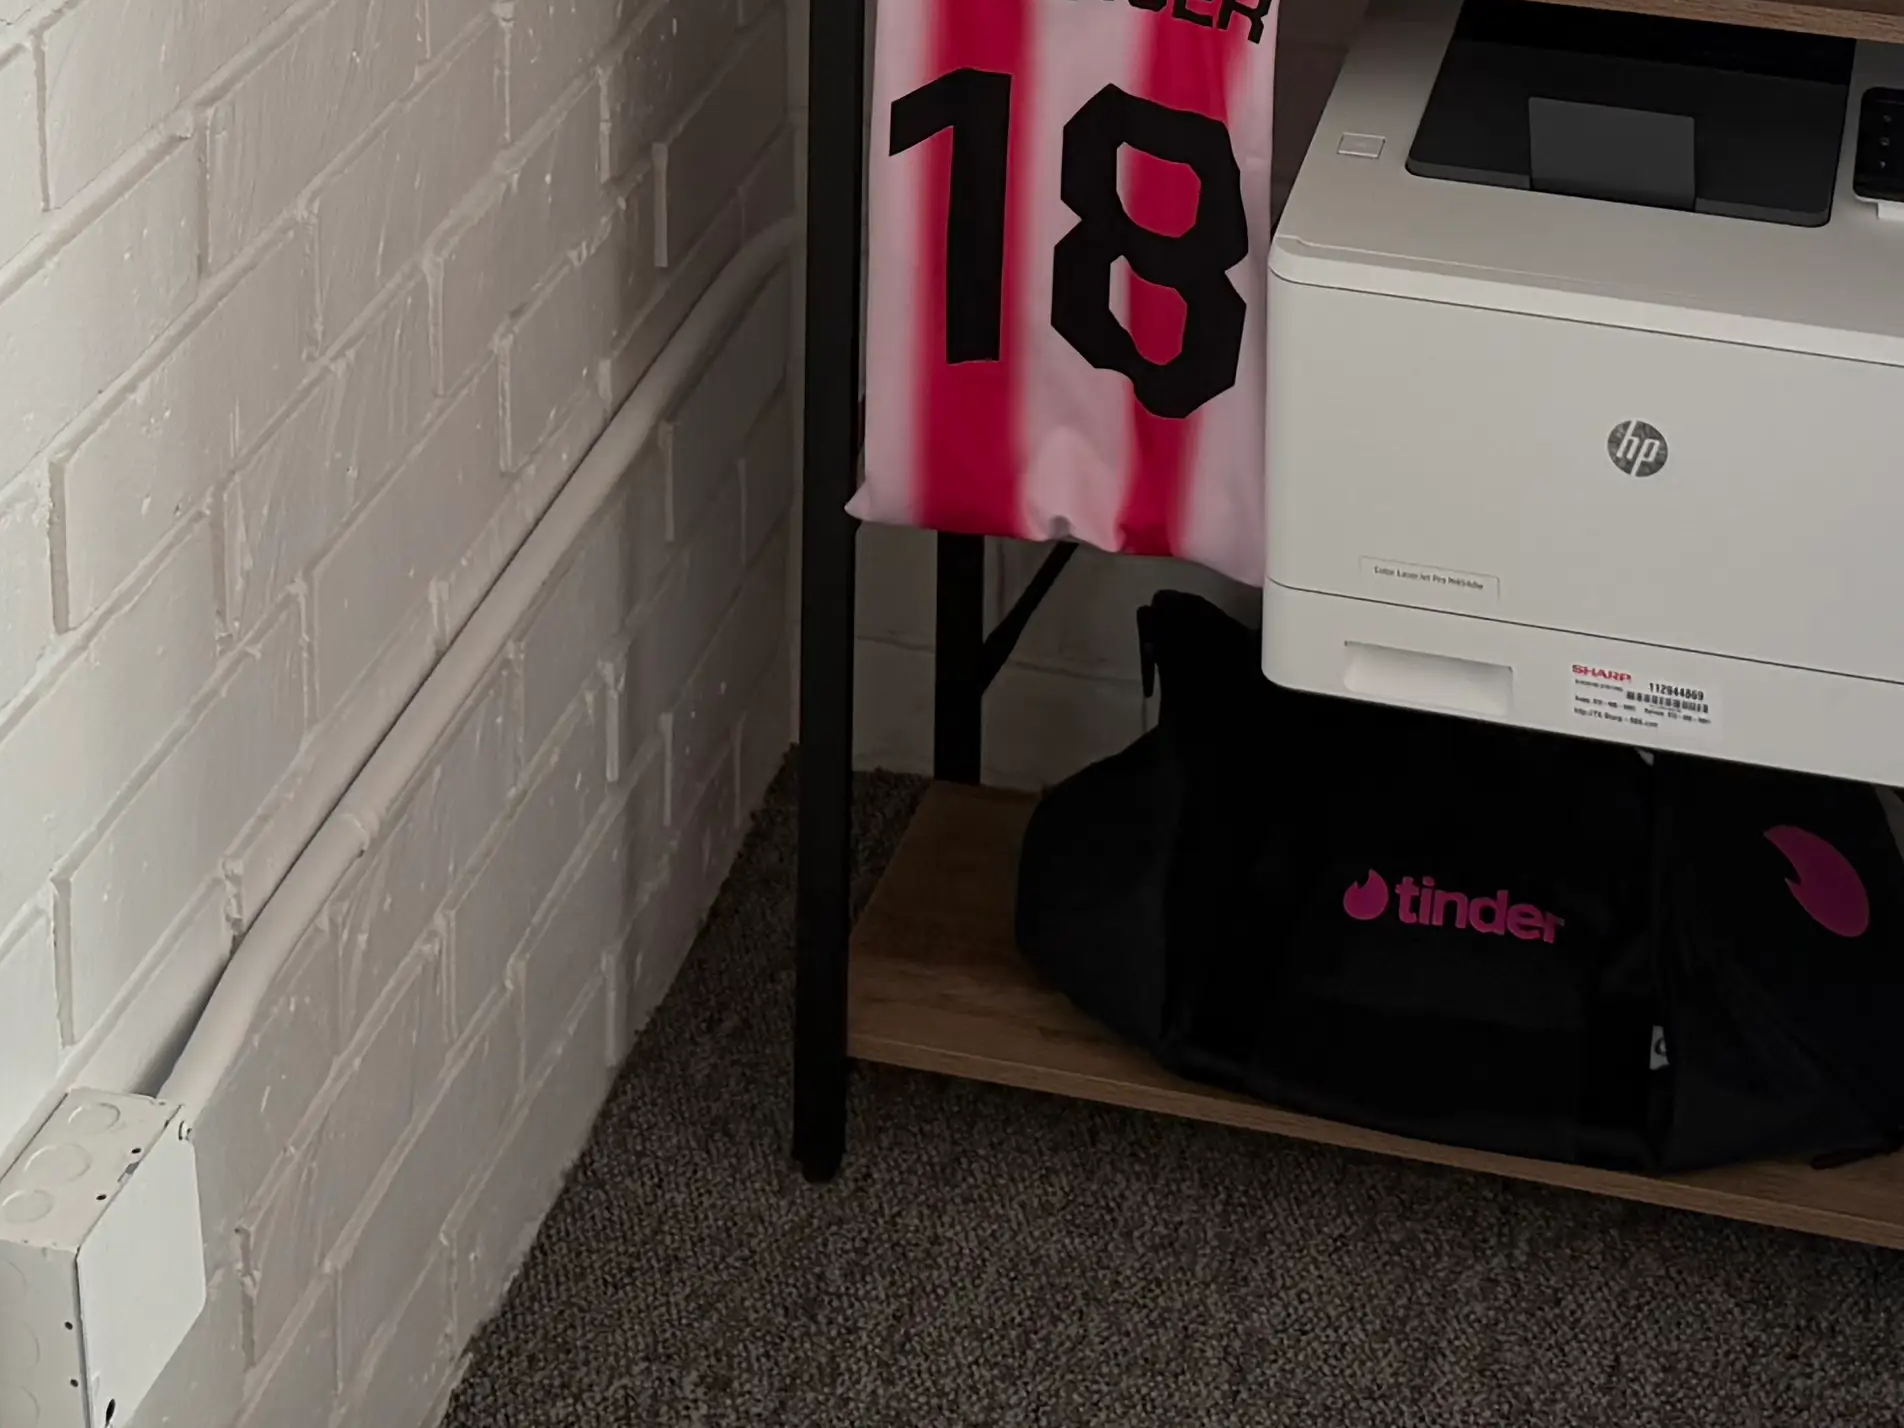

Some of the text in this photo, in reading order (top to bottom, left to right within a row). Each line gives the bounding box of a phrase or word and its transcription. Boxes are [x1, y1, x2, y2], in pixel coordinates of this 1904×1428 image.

[888, 66, 1249, 420] 18
[1614, 420, 1661, 477] hp
[1572, 664, 1632, 682] SHARP
[1394, 875, 1565, 944] tinder
